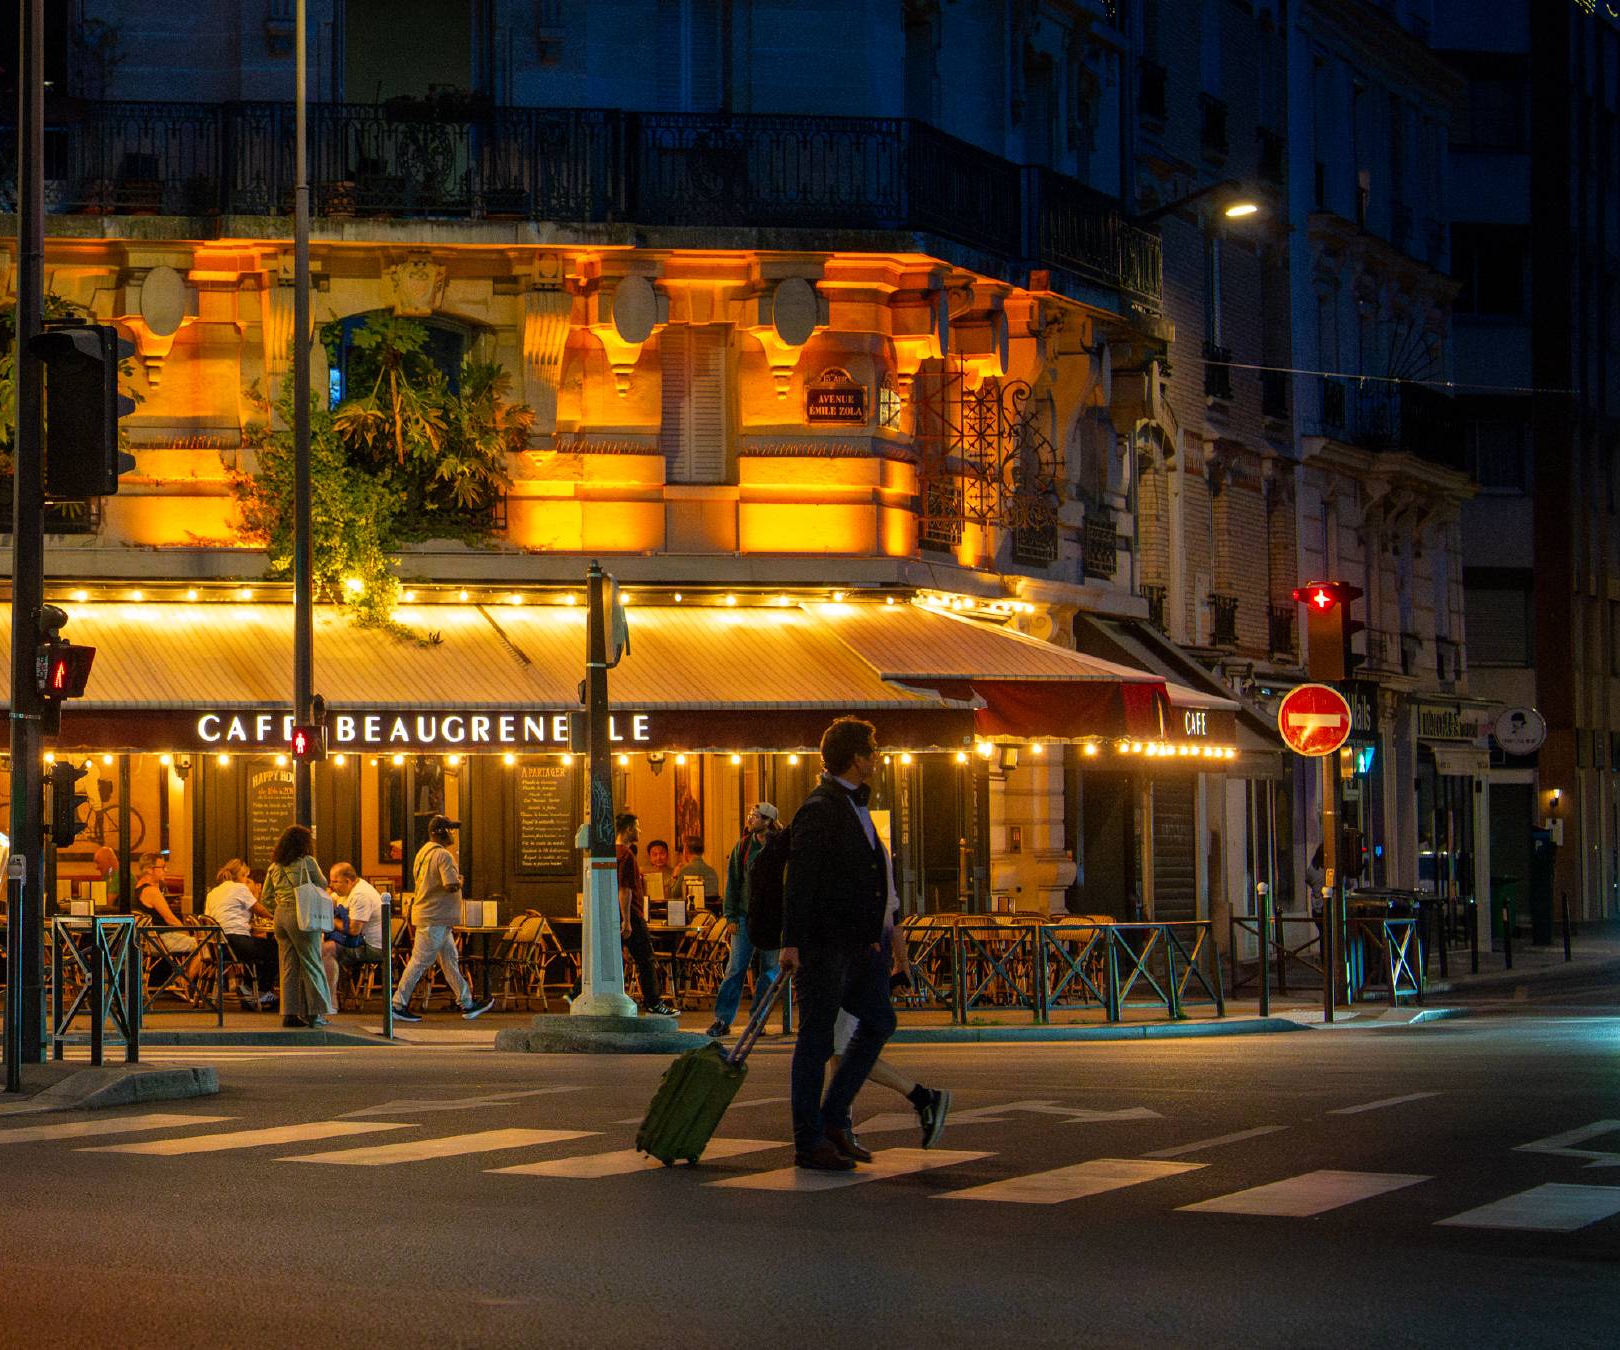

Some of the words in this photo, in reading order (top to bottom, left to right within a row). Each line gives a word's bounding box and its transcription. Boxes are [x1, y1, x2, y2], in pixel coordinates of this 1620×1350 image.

[819, 394, 854, 403] AVENUE
[809, 403, 837, 415] ÉMILE
[839, 406, 863, 416] ZOLA
[336, 715, 650, 743] BEAUGRENELE
[1185, 711, 1207, 737] CAFE
[252, 770, 278, 787] HAPPY
